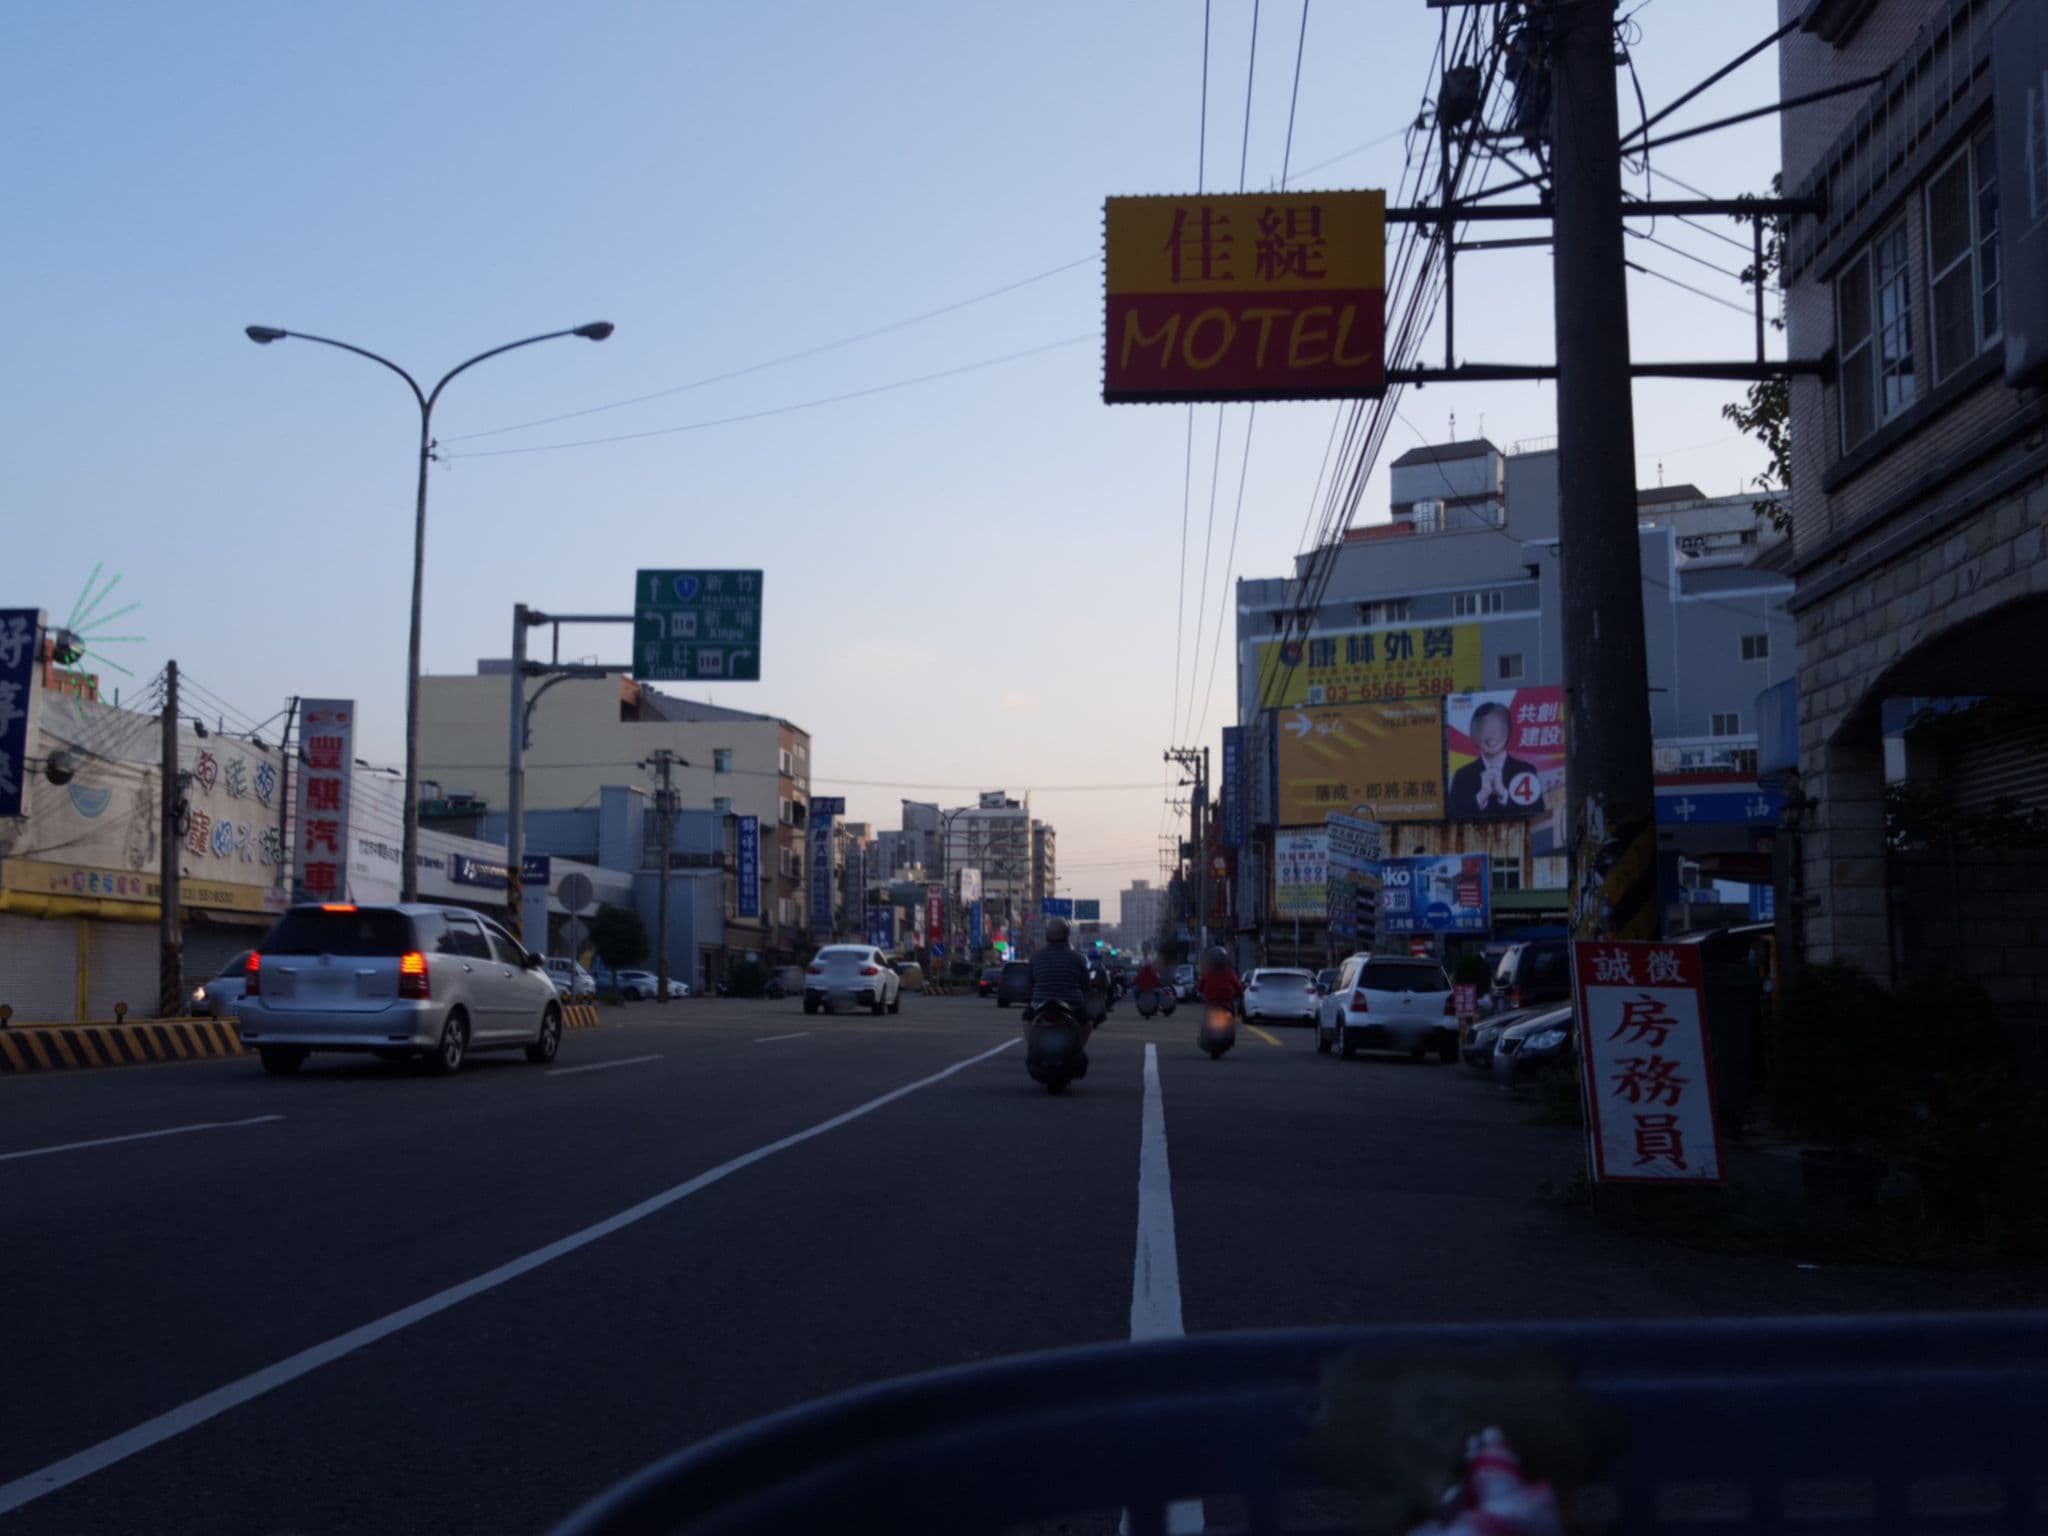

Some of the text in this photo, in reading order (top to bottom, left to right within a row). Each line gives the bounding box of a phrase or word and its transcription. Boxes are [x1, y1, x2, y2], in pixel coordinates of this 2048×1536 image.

[1166, 204, 1328, 284] 佳緹
[1120, 304, 1372, 371] MOTEL
[1308, 627, 1454, 667] 康林外勞
[1326, 677, 1455, 703] 03-6566-588
[1514, 776, 1533, 802] 4
[1672, 796, 1771, 823] 中油
[1592, 948, 1687, 985] 誠徵
[1608, 994, 1689, 1170] 房務員
